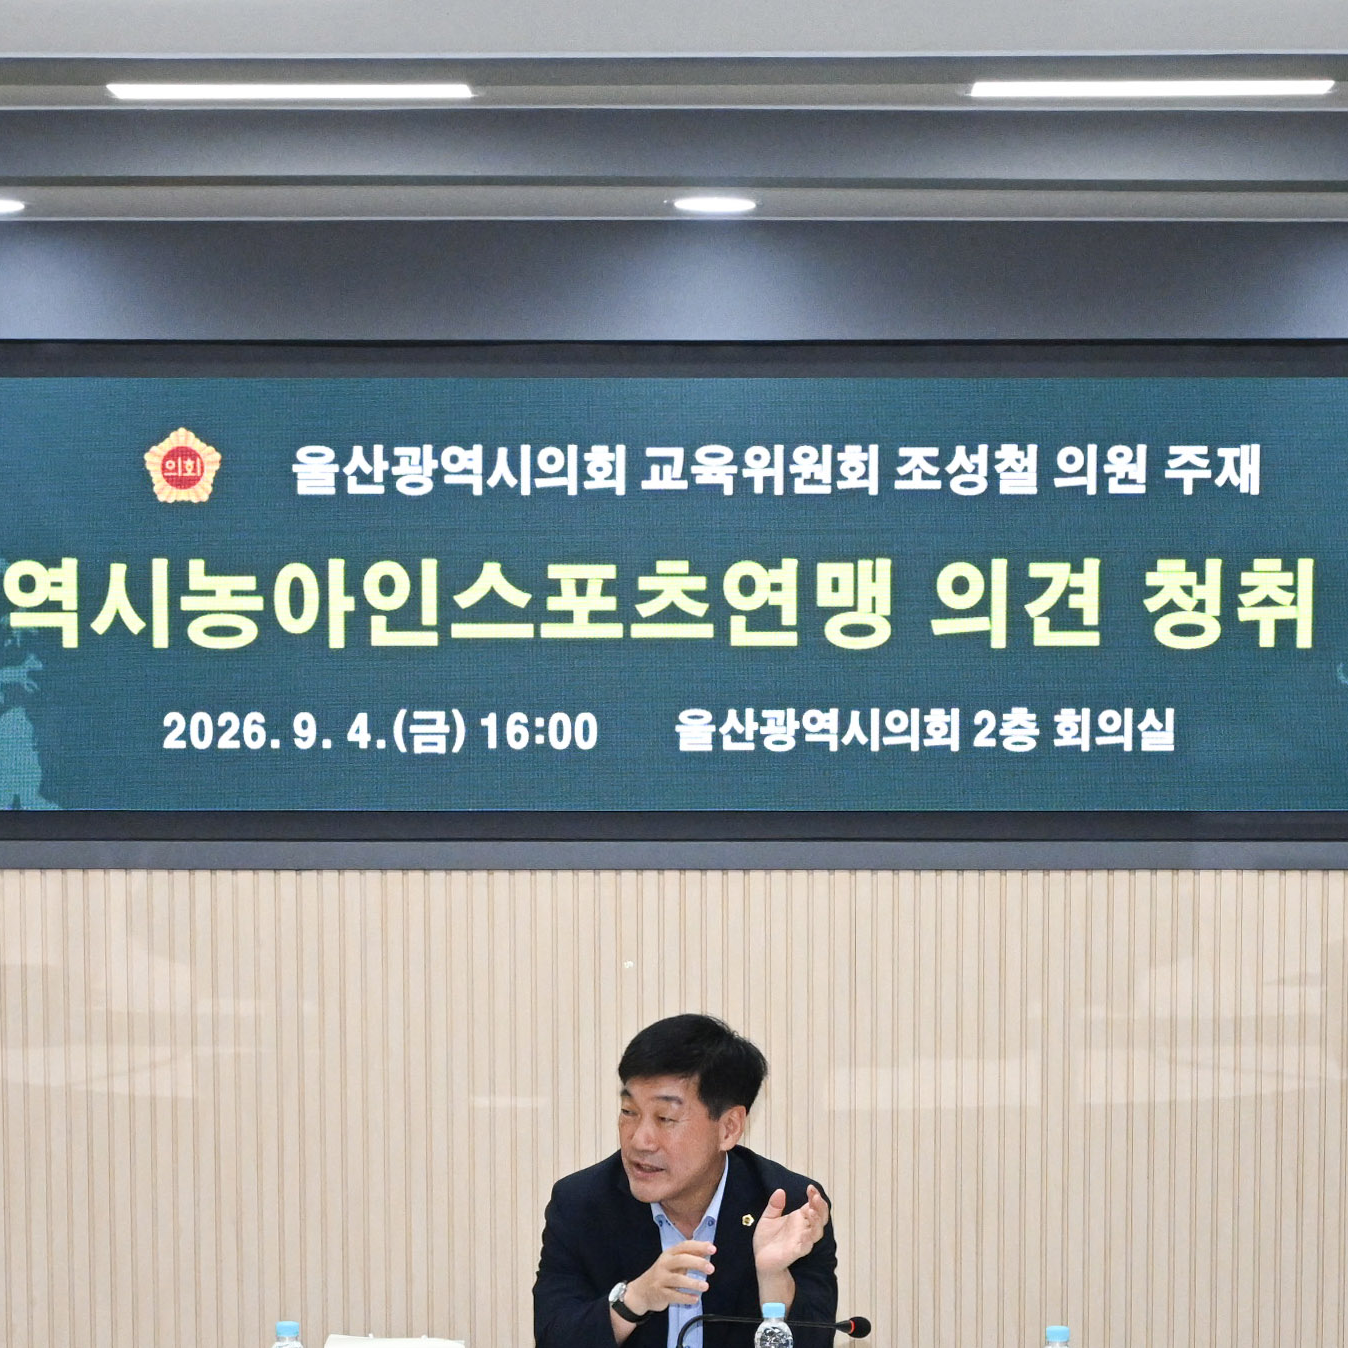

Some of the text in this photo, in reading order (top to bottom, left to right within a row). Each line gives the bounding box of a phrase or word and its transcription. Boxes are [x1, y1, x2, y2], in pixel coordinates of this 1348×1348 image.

[163, 456, 202, 477] 의회
[291, 443, 1262, 496] 울산광역시의회 교육위원회 조성철 의원 주재
[930, 557, 1101, 650] 의견
[1142, 557, 1315, 650] 청취
[162, 708, 599, 754] 2026. 9. 4.(금) 16:00
[675, 707, 1176, 753] 울산광역시의회 2층 회의실
